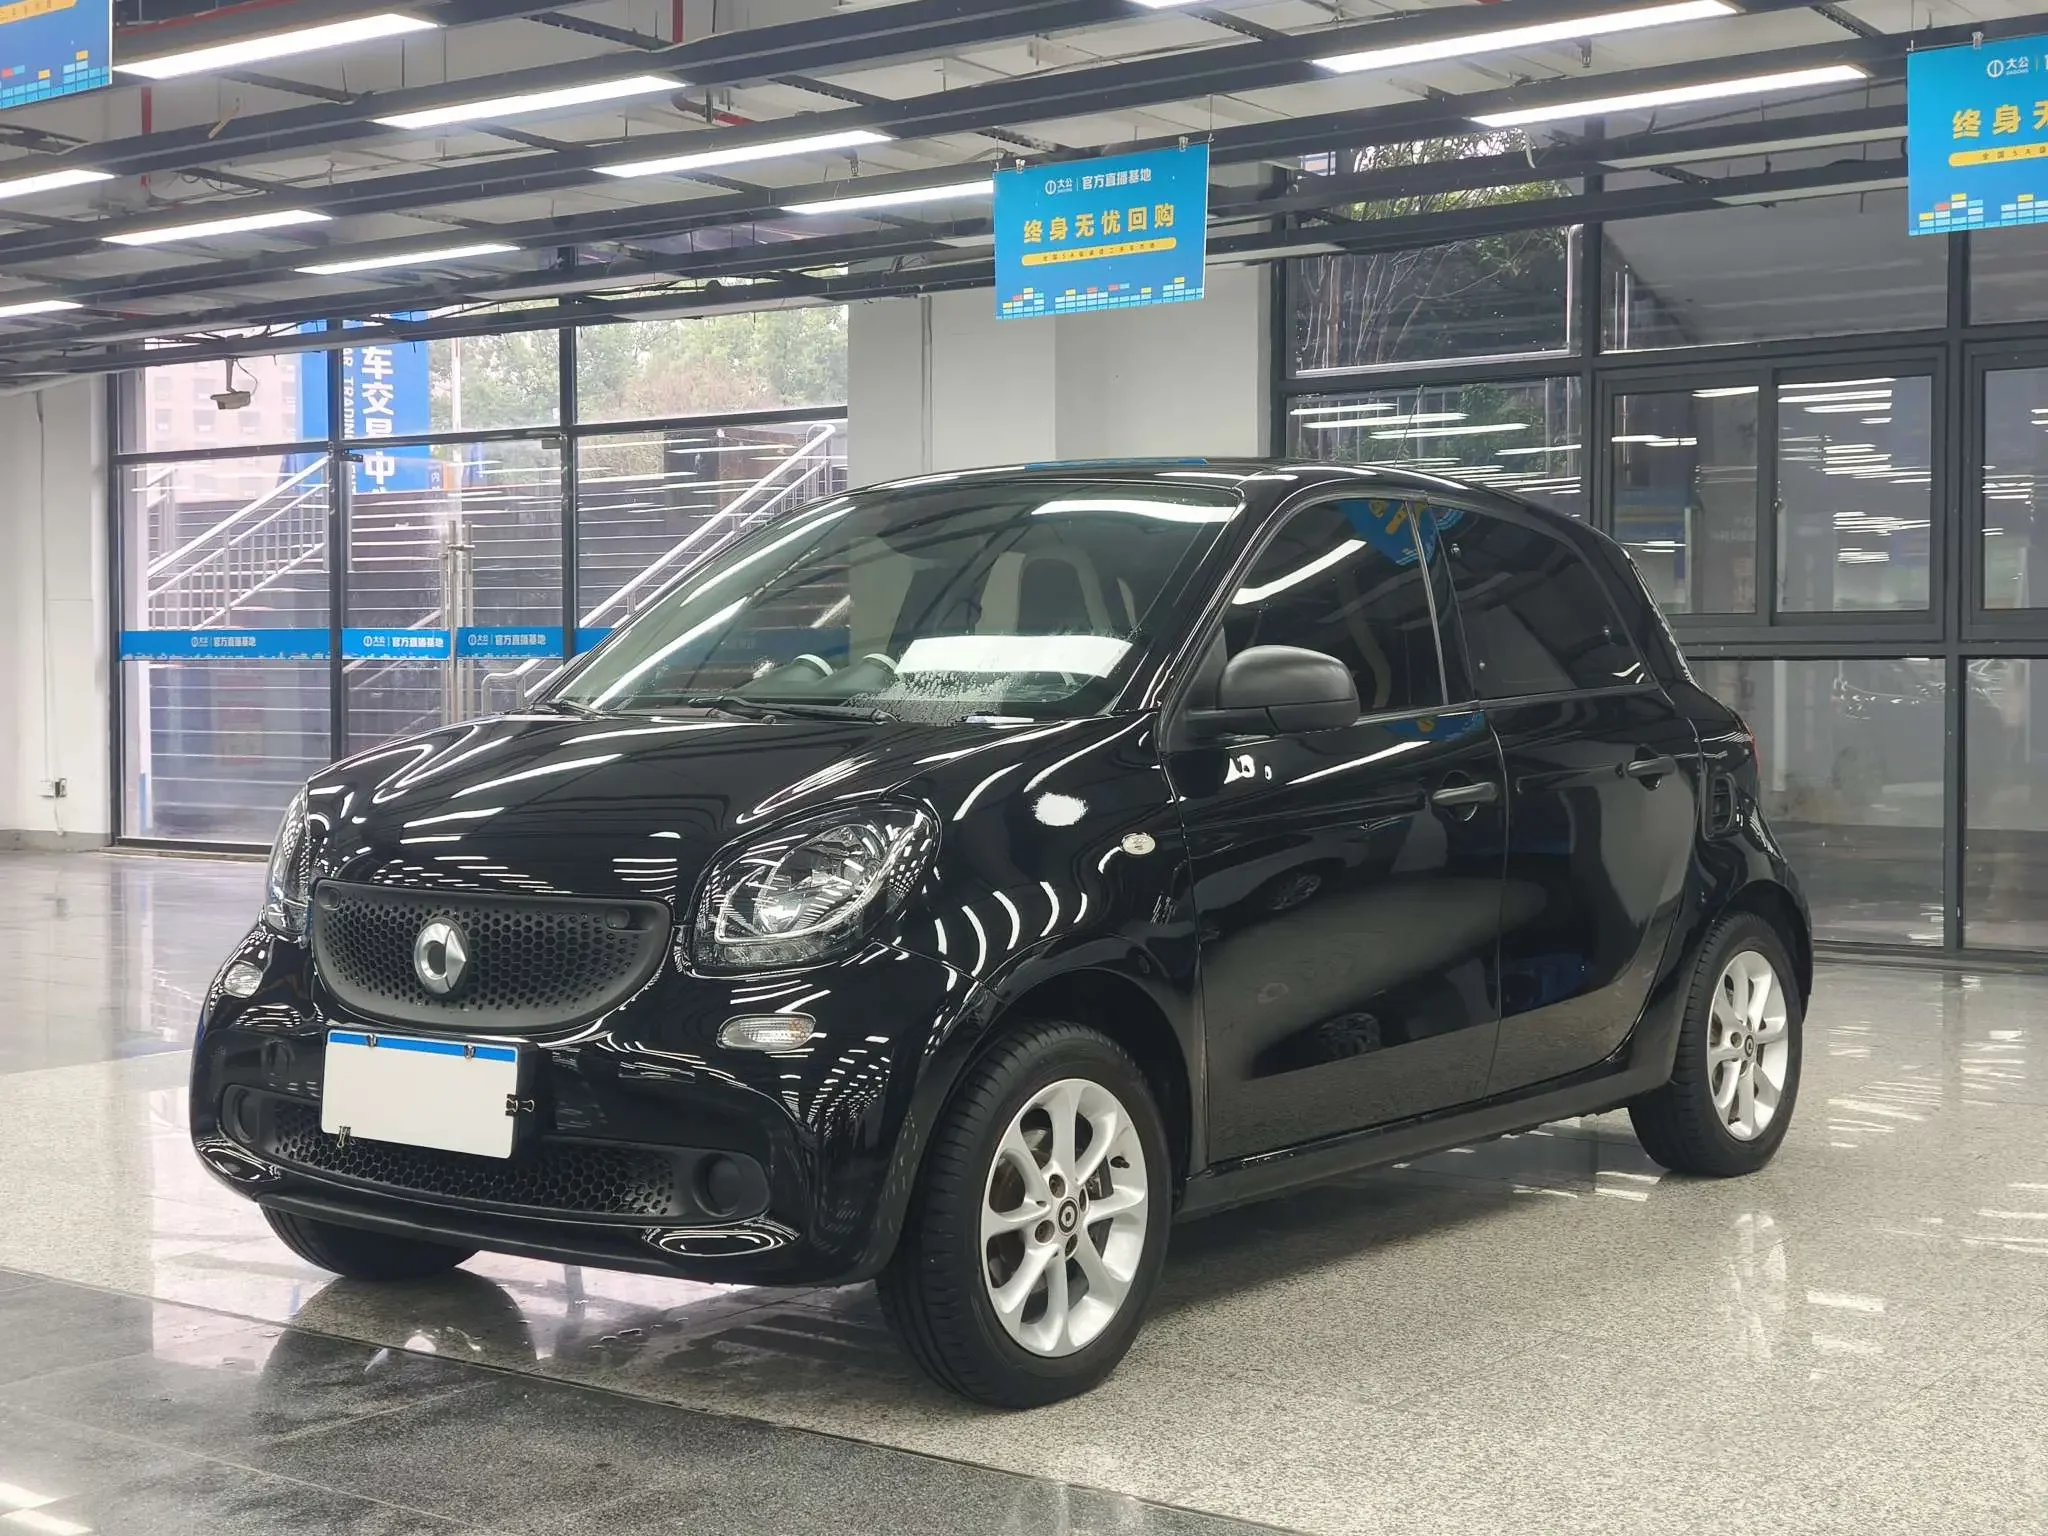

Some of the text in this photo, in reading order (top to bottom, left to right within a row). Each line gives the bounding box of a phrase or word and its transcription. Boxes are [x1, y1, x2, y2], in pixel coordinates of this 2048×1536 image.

[2006, 56, 2029, 70] 大公
[1057, 167, 1152, 190] 大公 官方直播基地
[1023, 203, 1174, 244] 终身无忧回购
